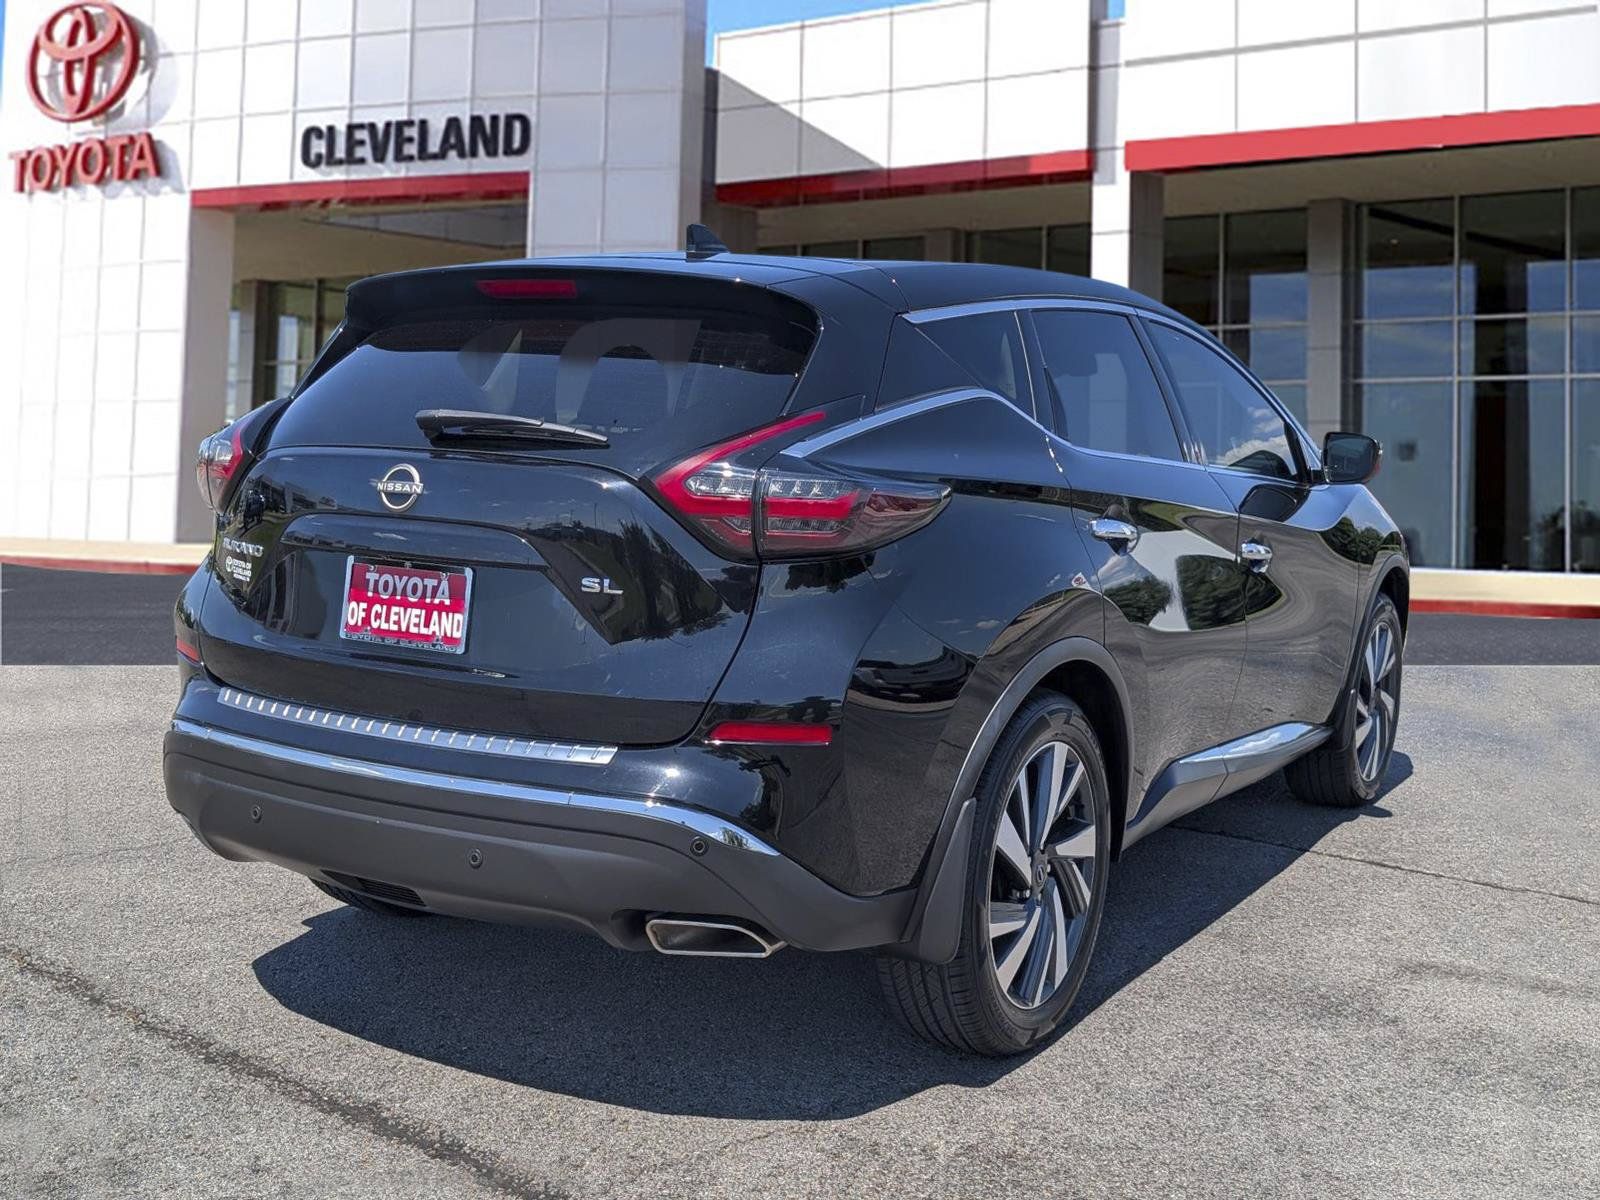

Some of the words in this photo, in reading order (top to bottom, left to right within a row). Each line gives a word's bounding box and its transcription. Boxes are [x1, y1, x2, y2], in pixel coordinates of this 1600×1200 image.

[301, 113, 531, 168] CLEVELAND
[9, 132, 161, 193] TOYOTA
[377, 482, 423, 494] NISSAN
[366, 572, 451, 605] TOYOTA
[581, 577, 624, 594] SL
[347, 601, 368, 626] OF
[370, 604, 464, 638] CLEVELAND
